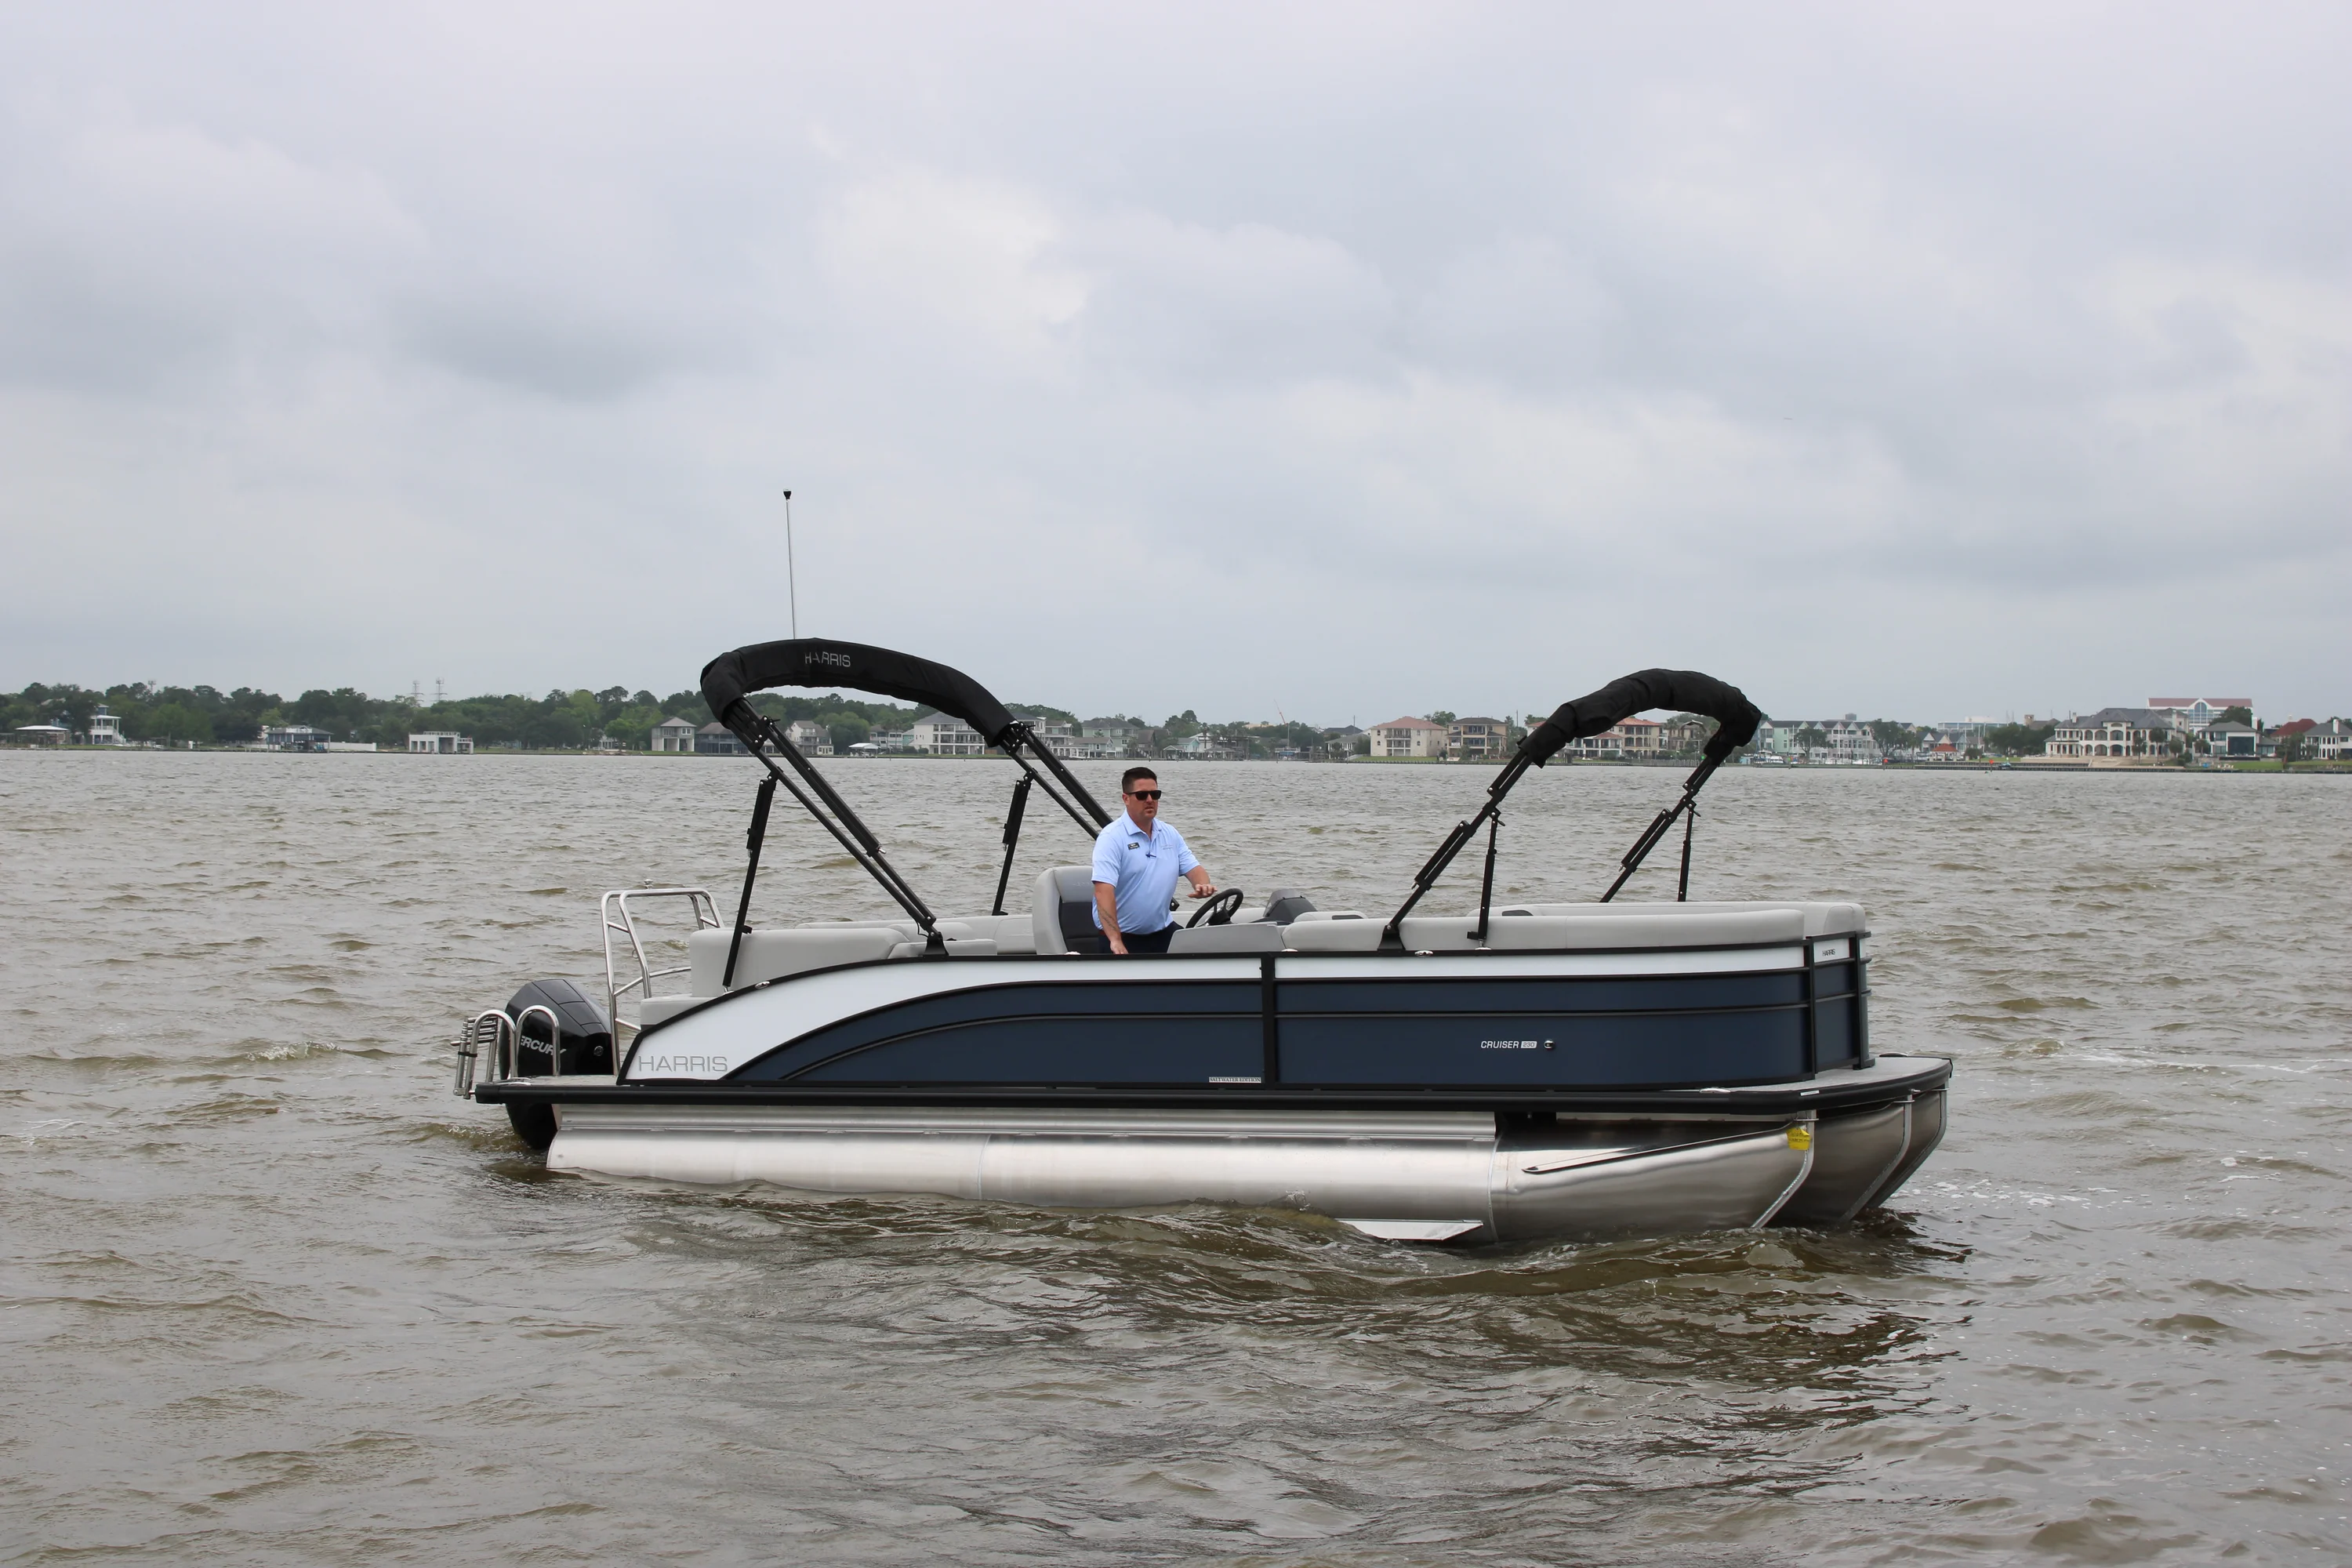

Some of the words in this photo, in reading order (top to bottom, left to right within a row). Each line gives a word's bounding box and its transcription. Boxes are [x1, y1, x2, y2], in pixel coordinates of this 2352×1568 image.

[804, 652, 851, 667] HARRIS
[520, 1036, 566, 1055] ERCUR
[1480, 1040, 1519, 1049] CRUISER
[638, 1055, 728, 1072] HARRIS
